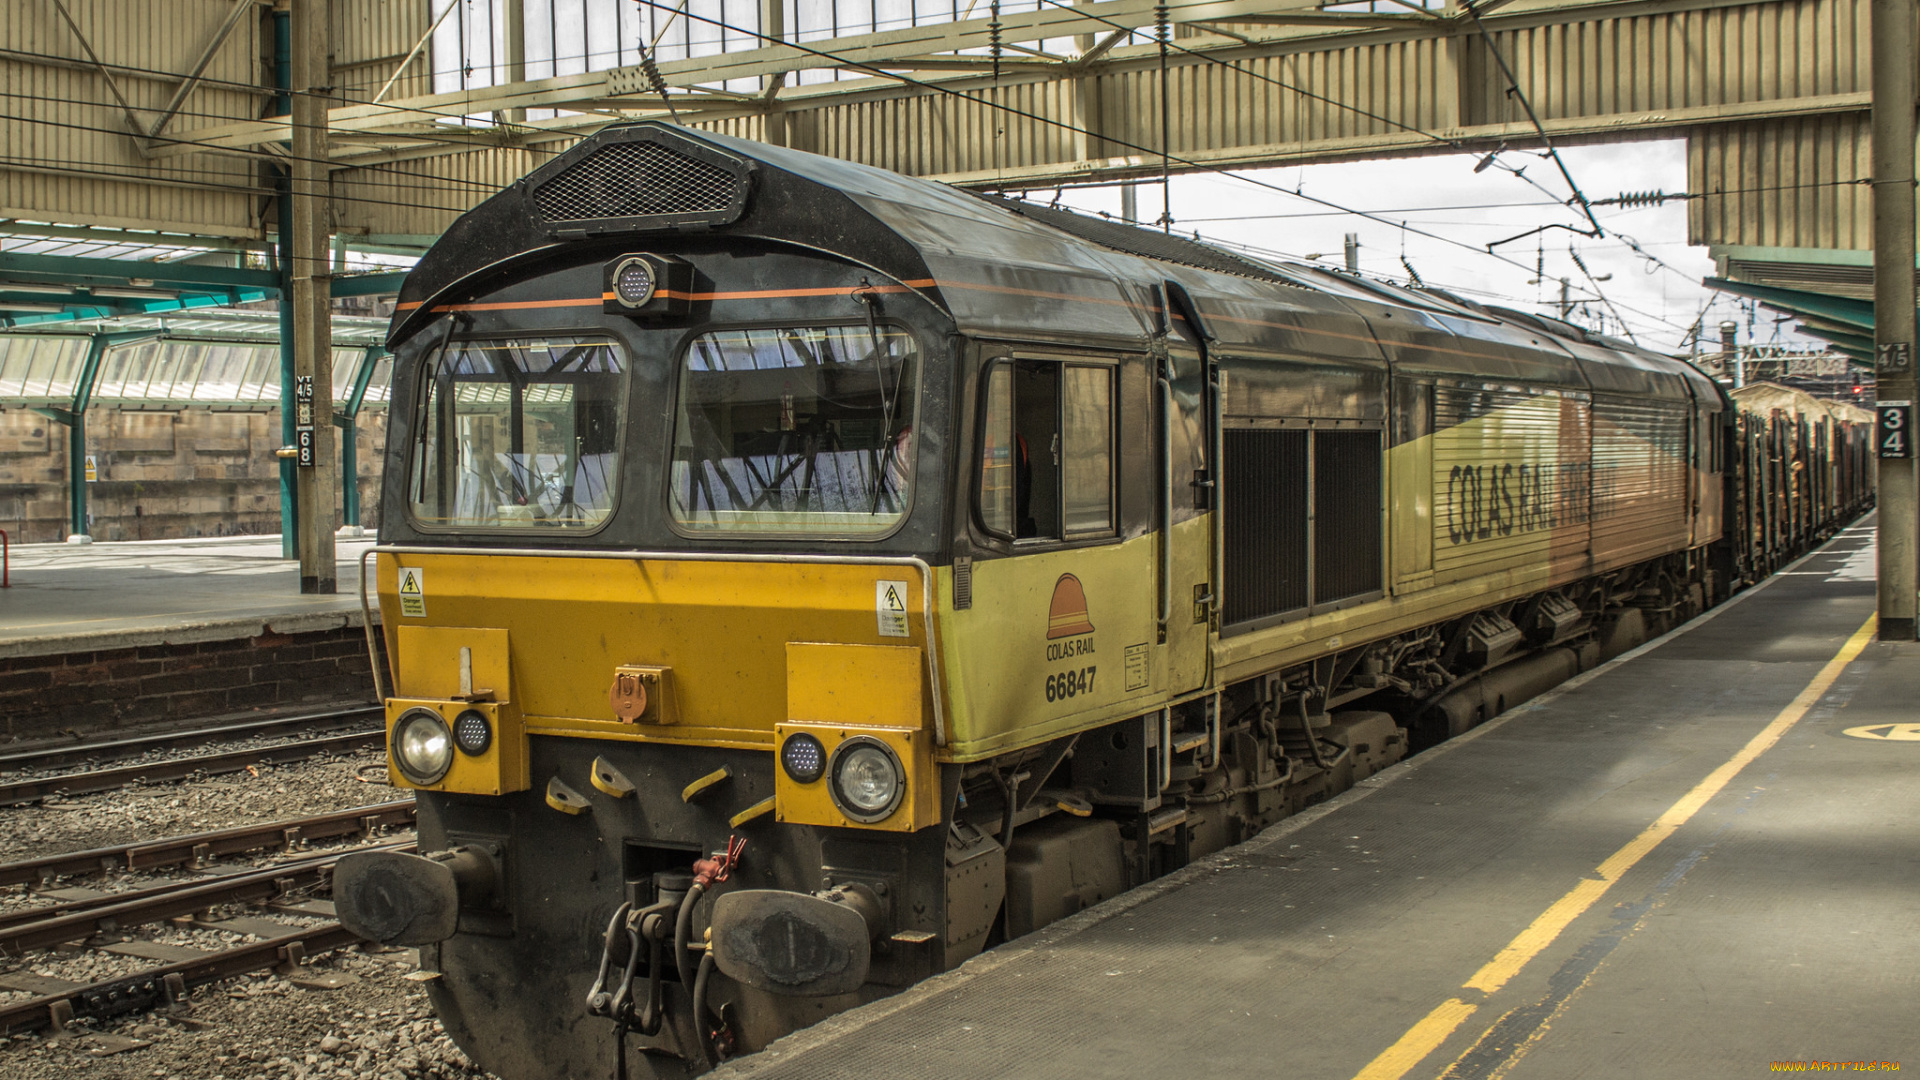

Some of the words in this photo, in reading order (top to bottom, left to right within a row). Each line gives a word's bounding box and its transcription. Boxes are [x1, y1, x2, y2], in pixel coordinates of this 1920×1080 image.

[1878, 343, 1907, 352] VT
[1878, 351, 1908, 368] 4/5
[297, 382, 313, 398] 4/5
[1883, 408, 1904, 429] 3
[301, 432, 310, 446] 6
[1883, 431, 1904, 452] 4
[301, 447, 310, 462] 8
[1449, 463, 1514, 545] COLAS
[1519, 463, 1557, 534] RAIL
[1046, 640, 1075, 661] COLAS
[1076, 637, 1095, 655] RAIL
[1045, 666, 1097, 703] 66847
